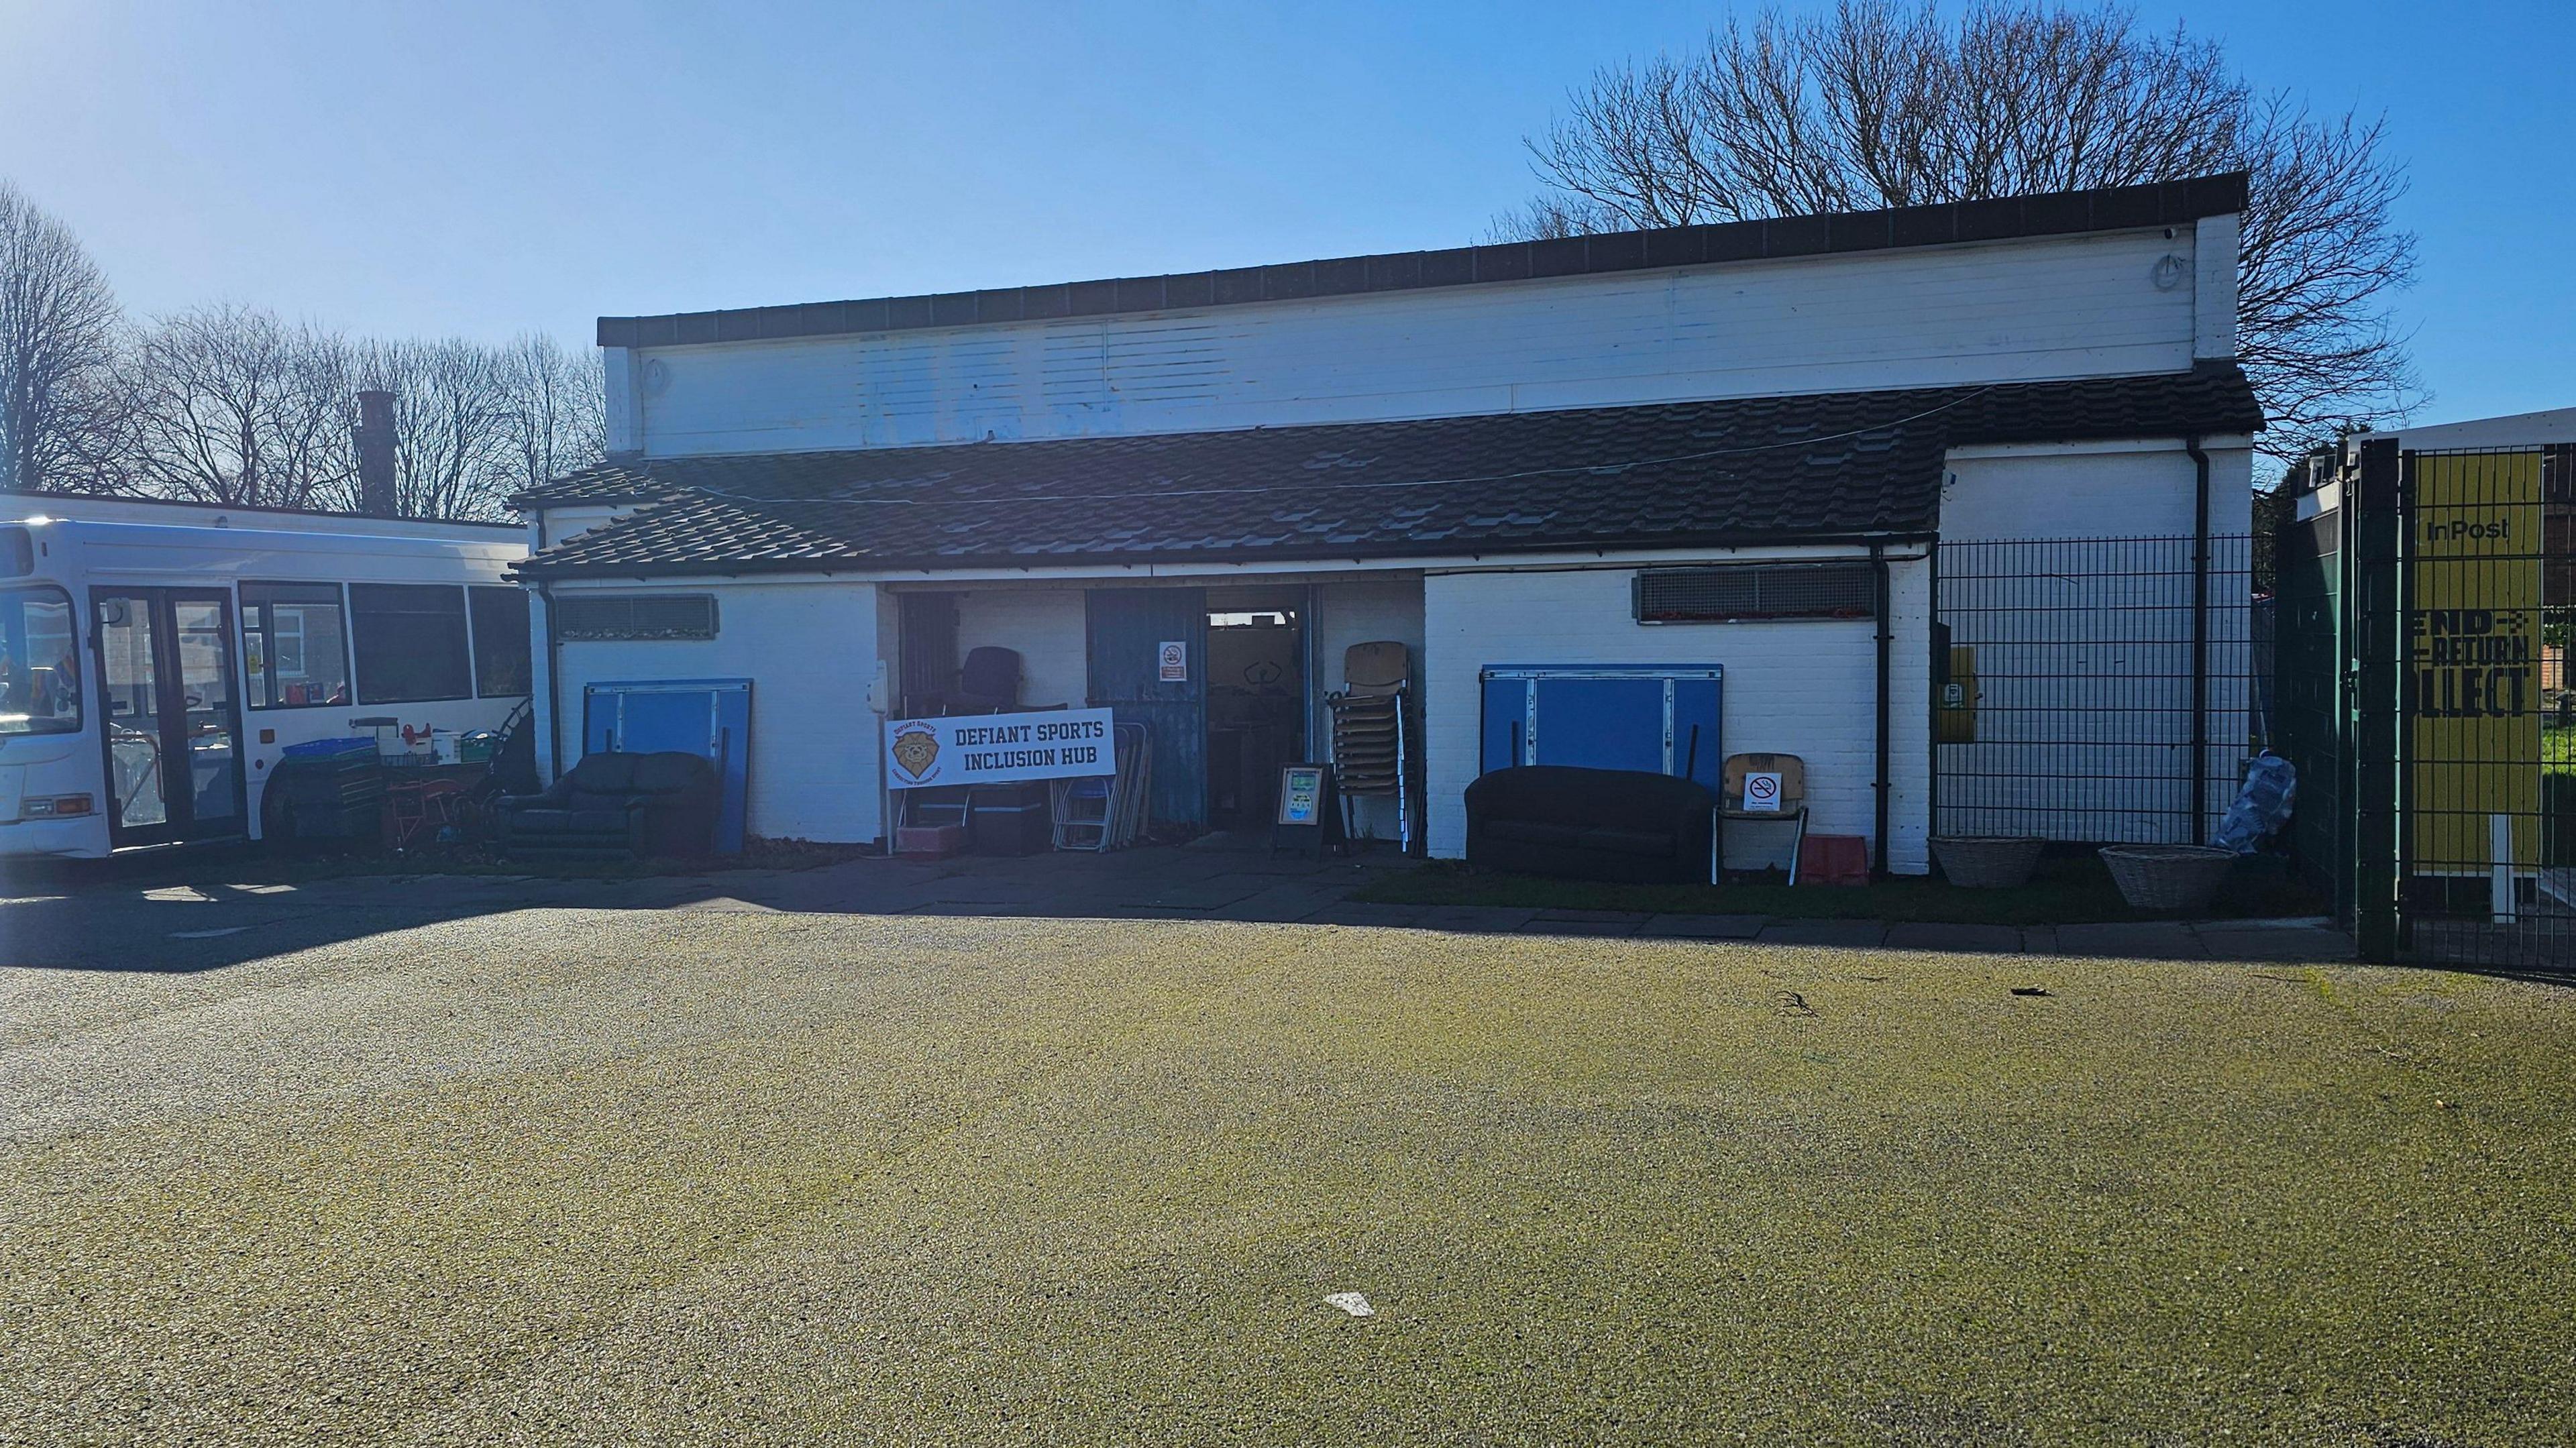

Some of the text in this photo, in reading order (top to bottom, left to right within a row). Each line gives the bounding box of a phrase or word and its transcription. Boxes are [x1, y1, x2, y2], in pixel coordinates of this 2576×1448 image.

[2427, 519, 2508, 541] InPost
[2414, 610, 2494, 636] END
[2432, 636, 2529, 666] RETURN
[2414, 667, 2530, 718] LLECT
[955, 720, 1104, 746] DEFIANT SPORTS
[965, 746, 1097, 771] INCLUSION HUB
